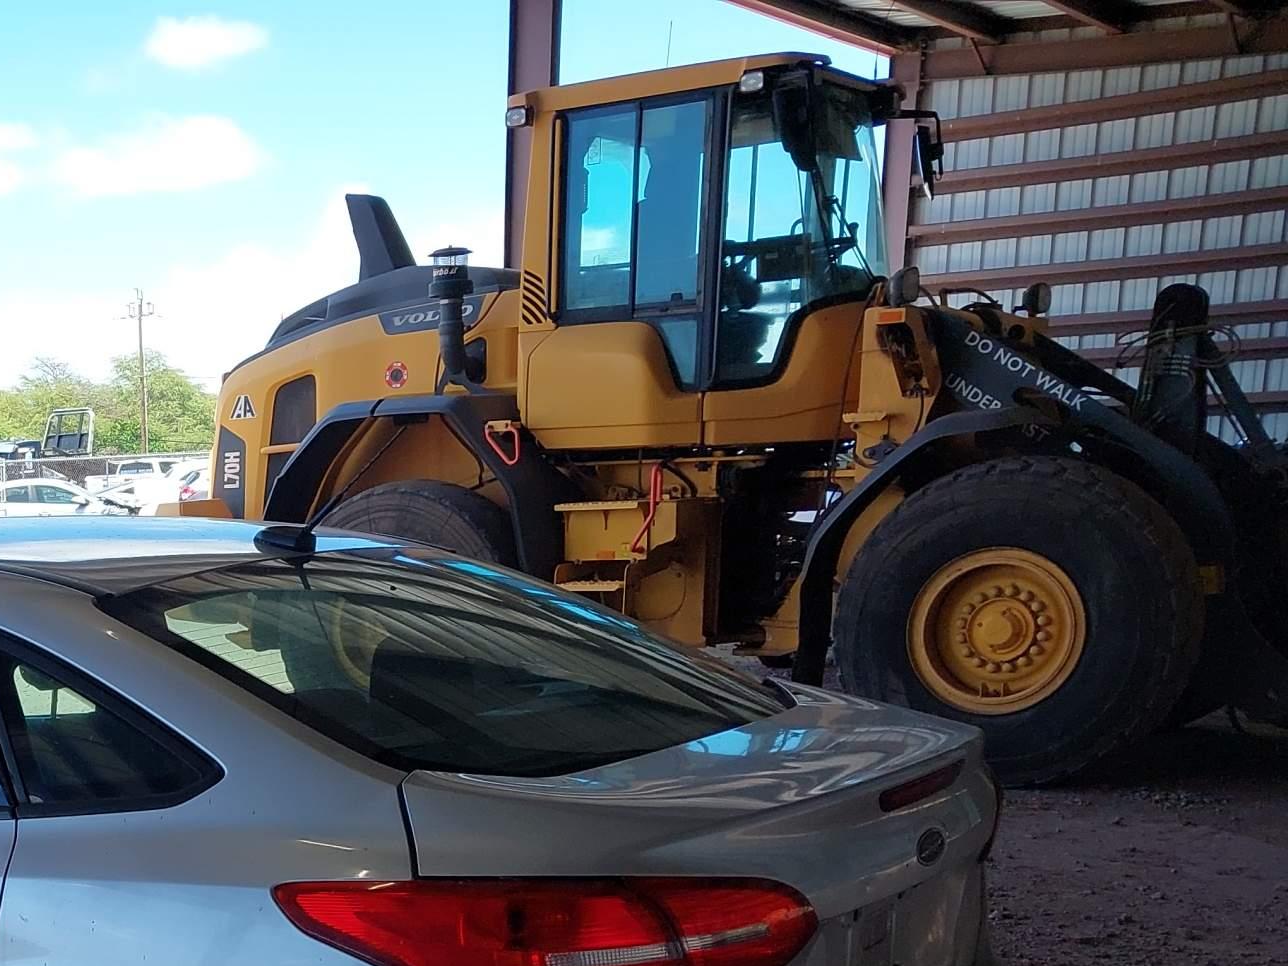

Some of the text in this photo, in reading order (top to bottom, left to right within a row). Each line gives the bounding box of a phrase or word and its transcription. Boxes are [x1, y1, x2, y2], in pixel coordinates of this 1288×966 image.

[391, 304, 474, 327] VOLO
[964, 330, 1088, 411] DO NOT WALK
[223, 451, 241, 489] L70H
